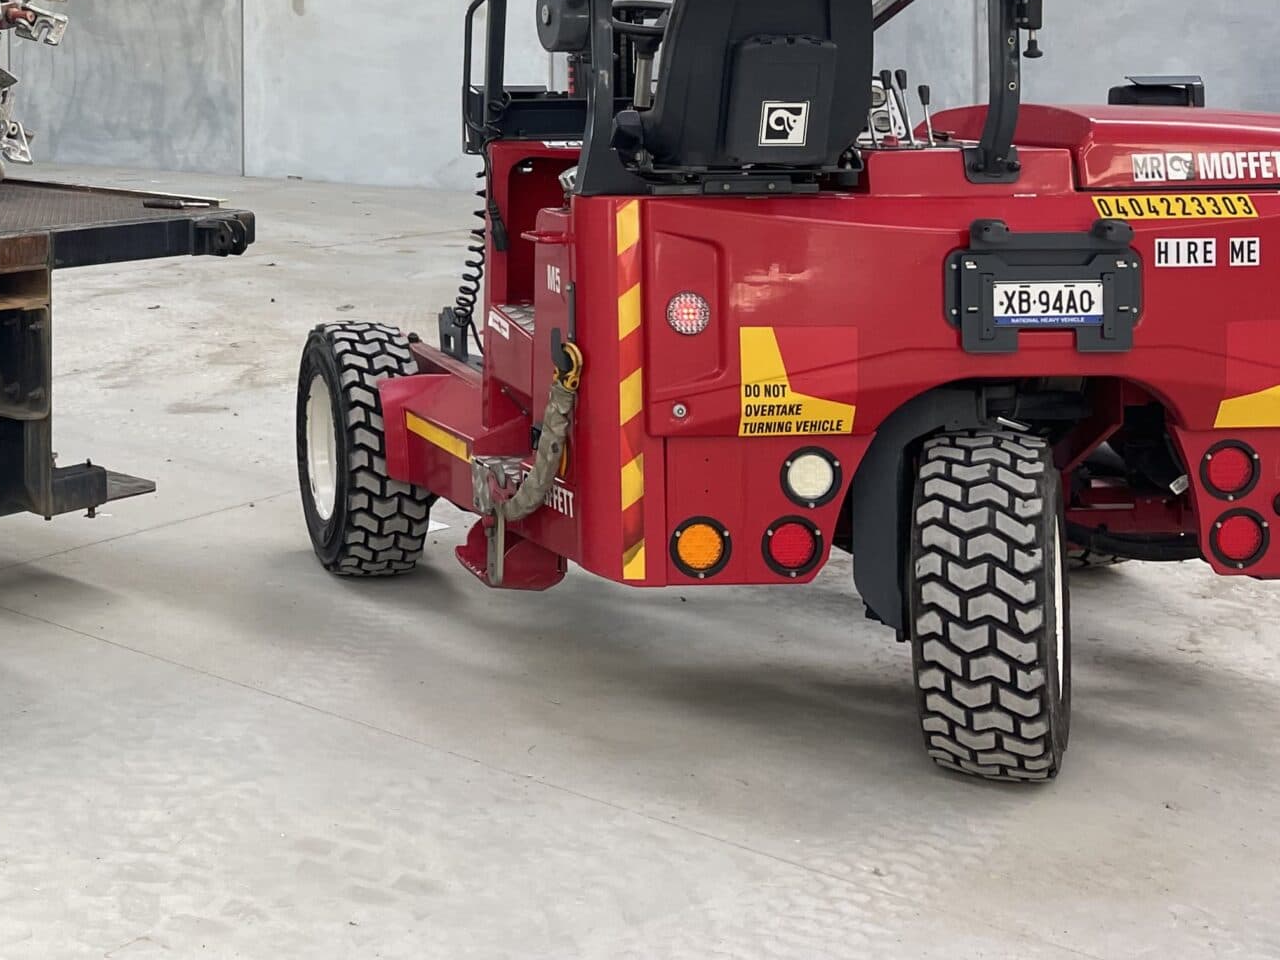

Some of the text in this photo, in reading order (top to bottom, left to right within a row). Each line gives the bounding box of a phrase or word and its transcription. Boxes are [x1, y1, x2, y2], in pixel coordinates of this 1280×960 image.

[1133, 155, 1163, 179] MR
[1096, 195, 1253, 217] 0404223303
[1157, 240, 1257, 264] HIRE ME
[547, 263, 561, 294] M5
[744, 384, 787, 398] DO NOT
[745, 404, 803, 417] OVERTAKE
[743, 419, 844, 434] TURNING VEHICLE
